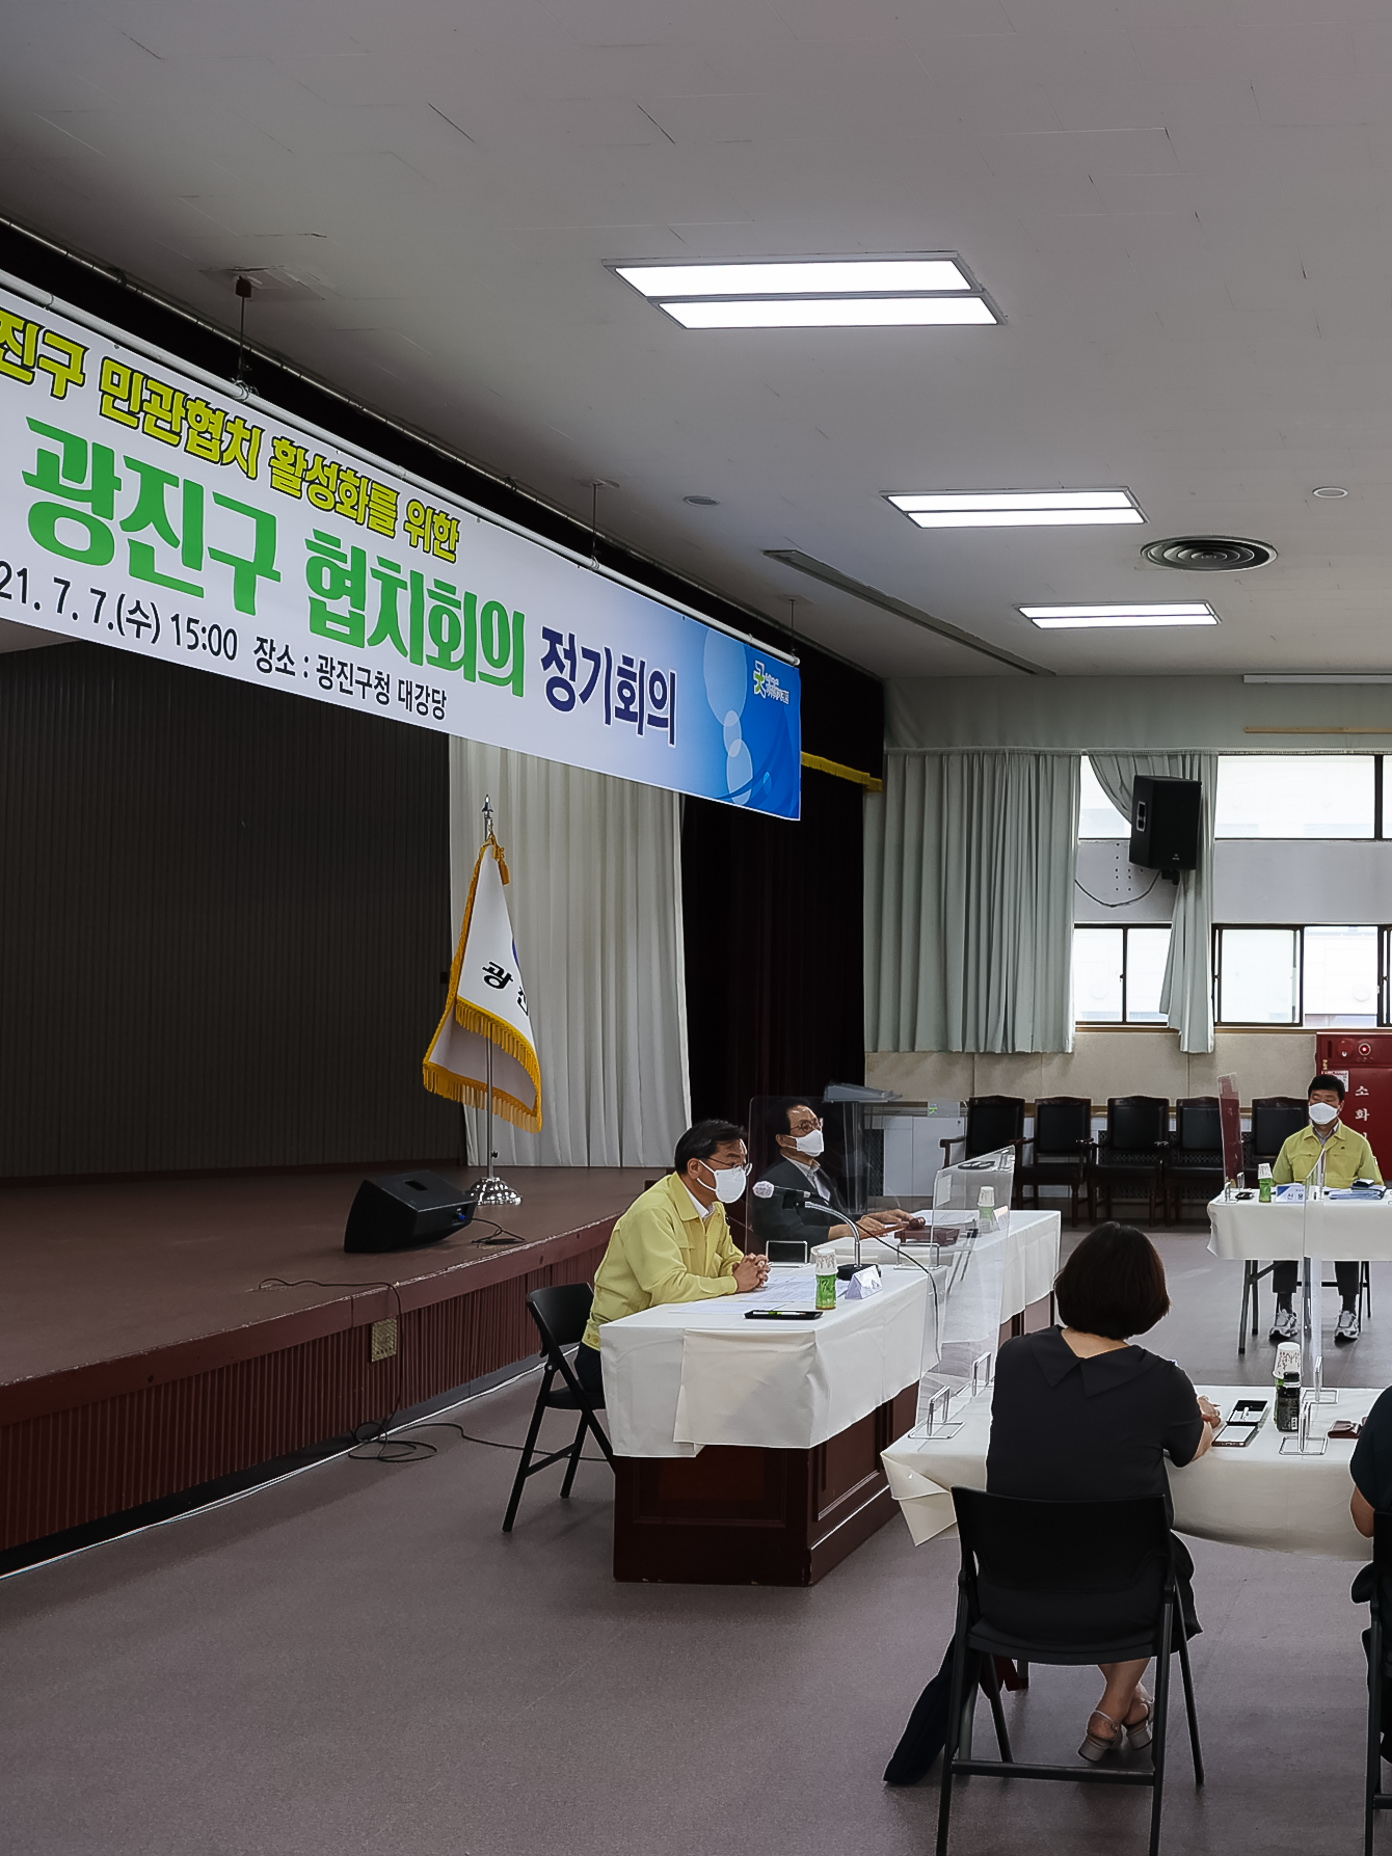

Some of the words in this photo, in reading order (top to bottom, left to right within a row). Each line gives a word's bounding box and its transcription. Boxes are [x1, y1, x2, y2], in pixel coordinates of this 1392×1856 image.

[0, 308, 90, 400] 진구
[99, 356, 265, 479] 민관협치
[268, 436, 400, 539] 활성화를
[404, 499, 460, 564] 위한
[22, 416, 281, 615] 광진구
[305, 528, 525, 698] 협치회의
[541, 626, 676, 745] 정기회의
[170, 613, 238, 661] 15:00
[316, 654, 391, 705] 광진구청
[398, 678, 447, 721] 대강당
